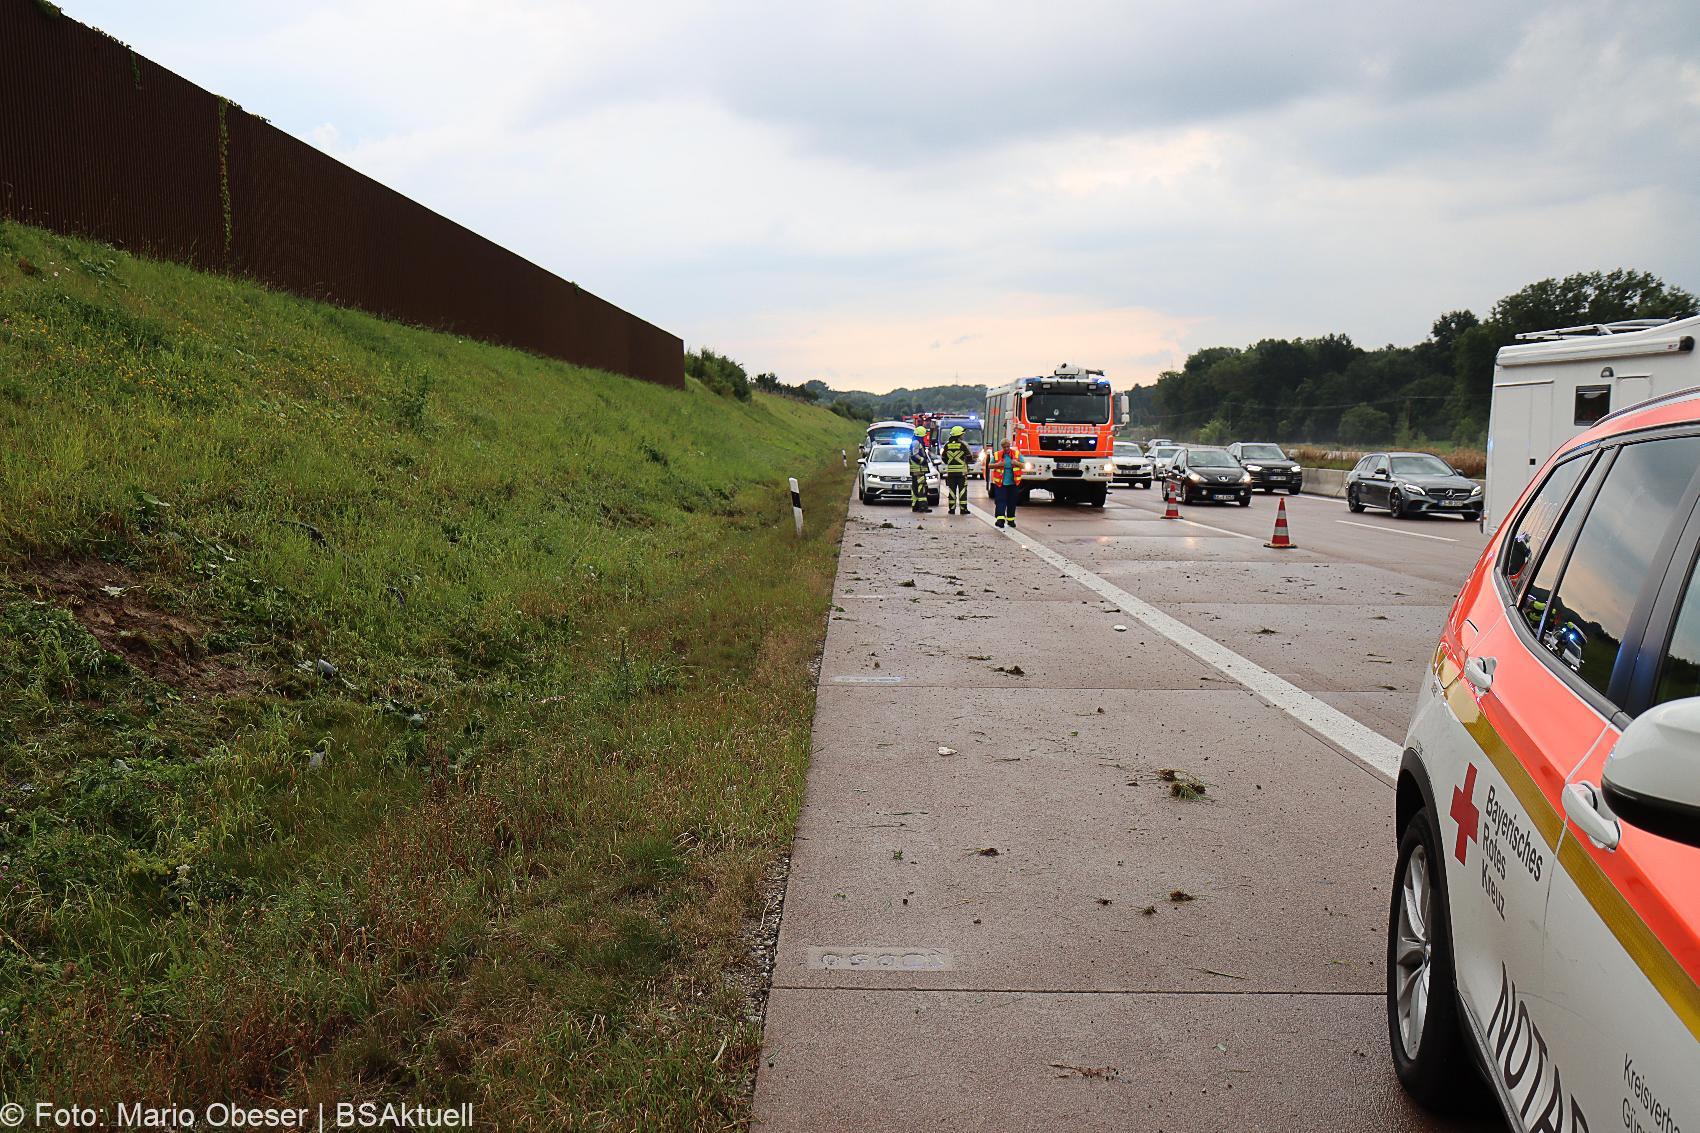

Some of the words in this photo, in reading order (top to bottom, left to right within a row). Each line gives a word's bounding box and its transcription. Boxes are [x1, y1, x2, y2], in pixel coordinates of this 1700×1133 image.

[1482, 821, 1507, 881] Rotes
[1485, 784, 1543, 882] Bayerisches
[1481, 858, 1506, 922] Kreuz
